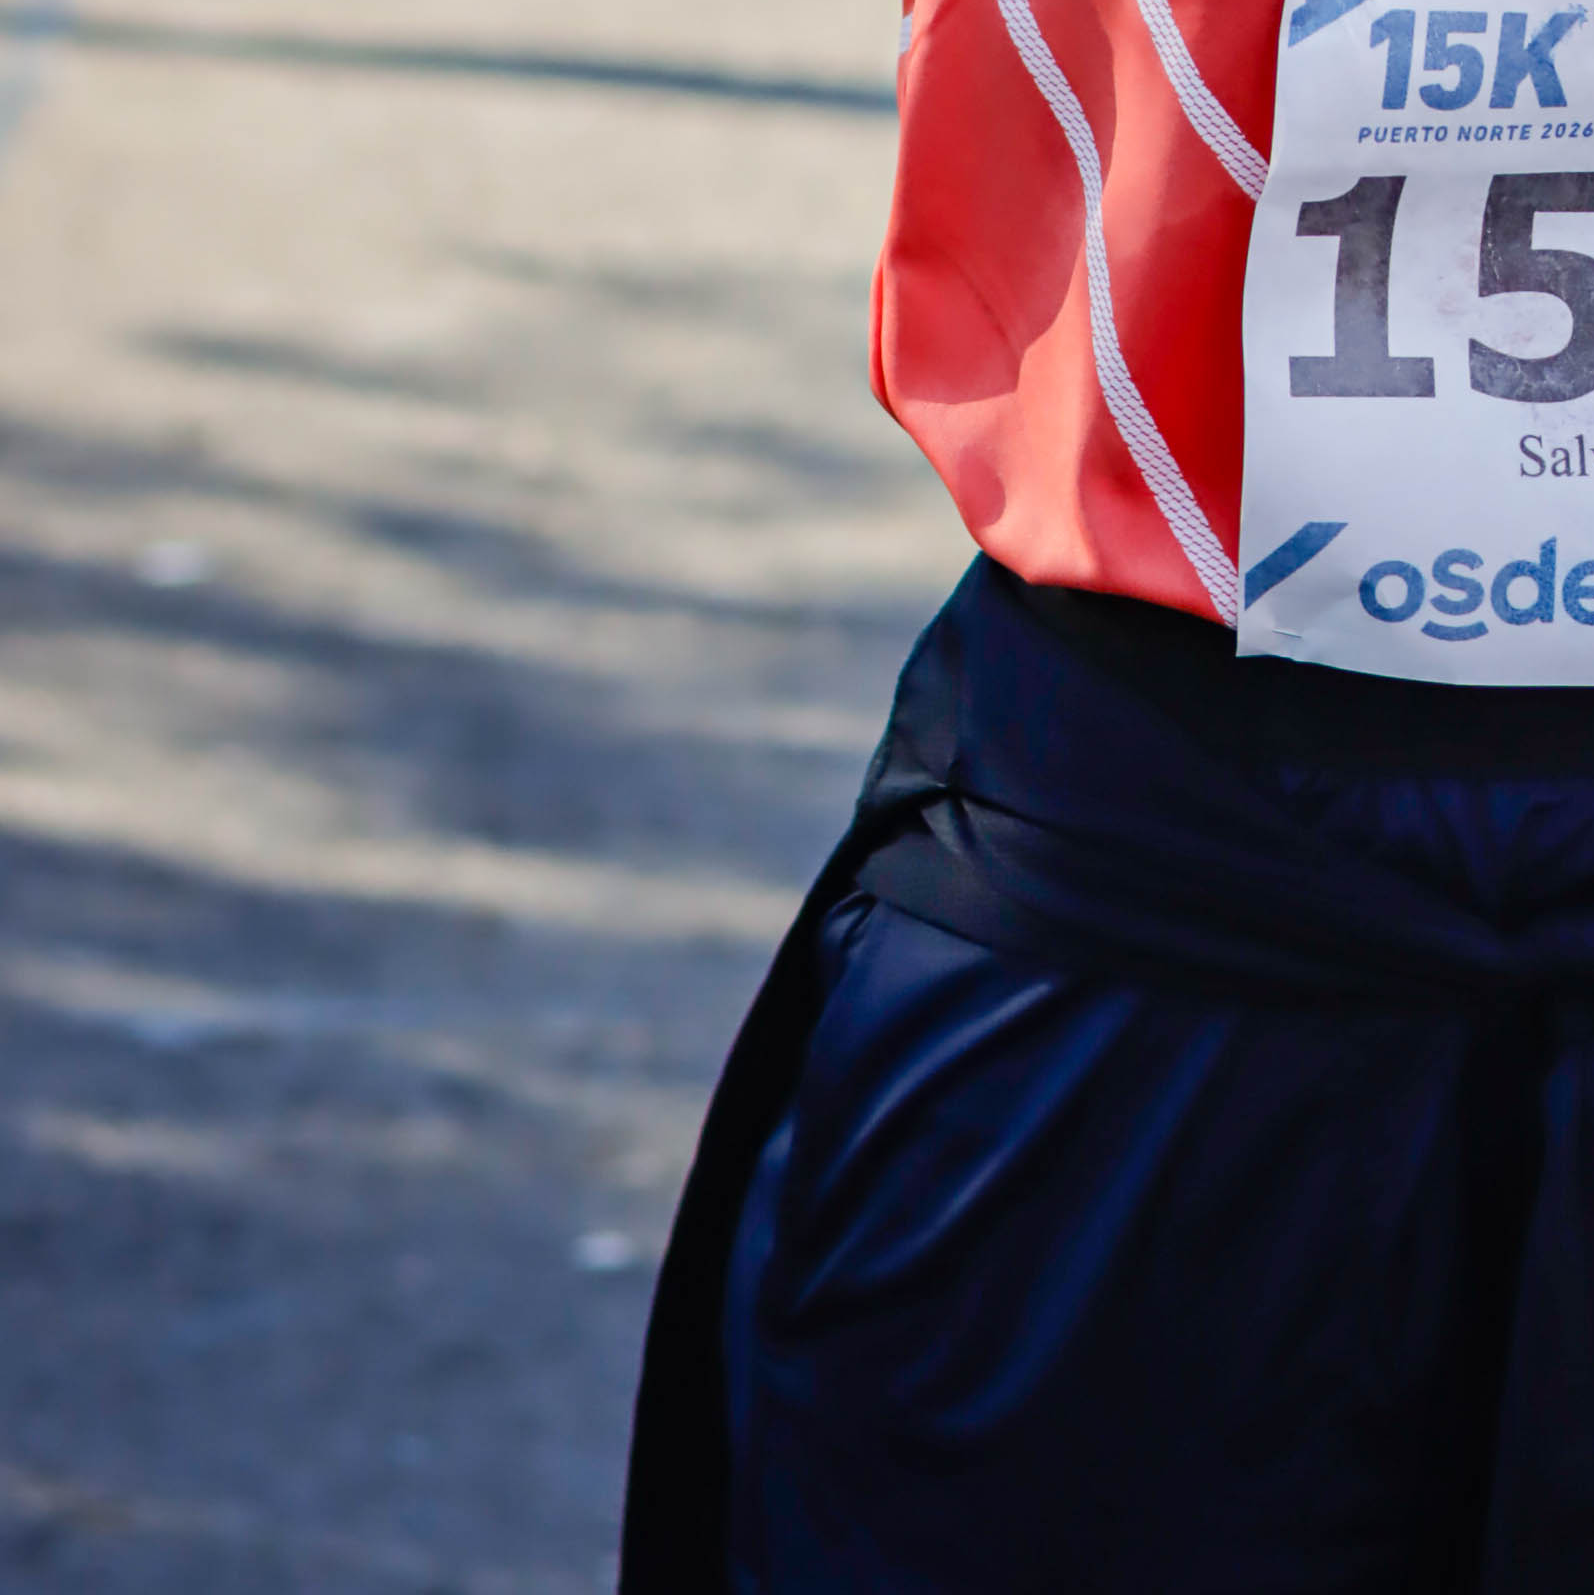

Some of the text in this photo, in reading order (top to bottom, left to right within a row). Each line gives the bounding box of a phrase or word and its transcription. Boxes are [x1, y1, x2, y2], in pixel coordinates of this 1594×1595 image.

[1369, 4, 1588, 111] 15K
[1357, 125, 1449, 143] PUERTO
[1457, 124, 1533, 142] NORTE
[1540, 122, 1594, 139] 2026
